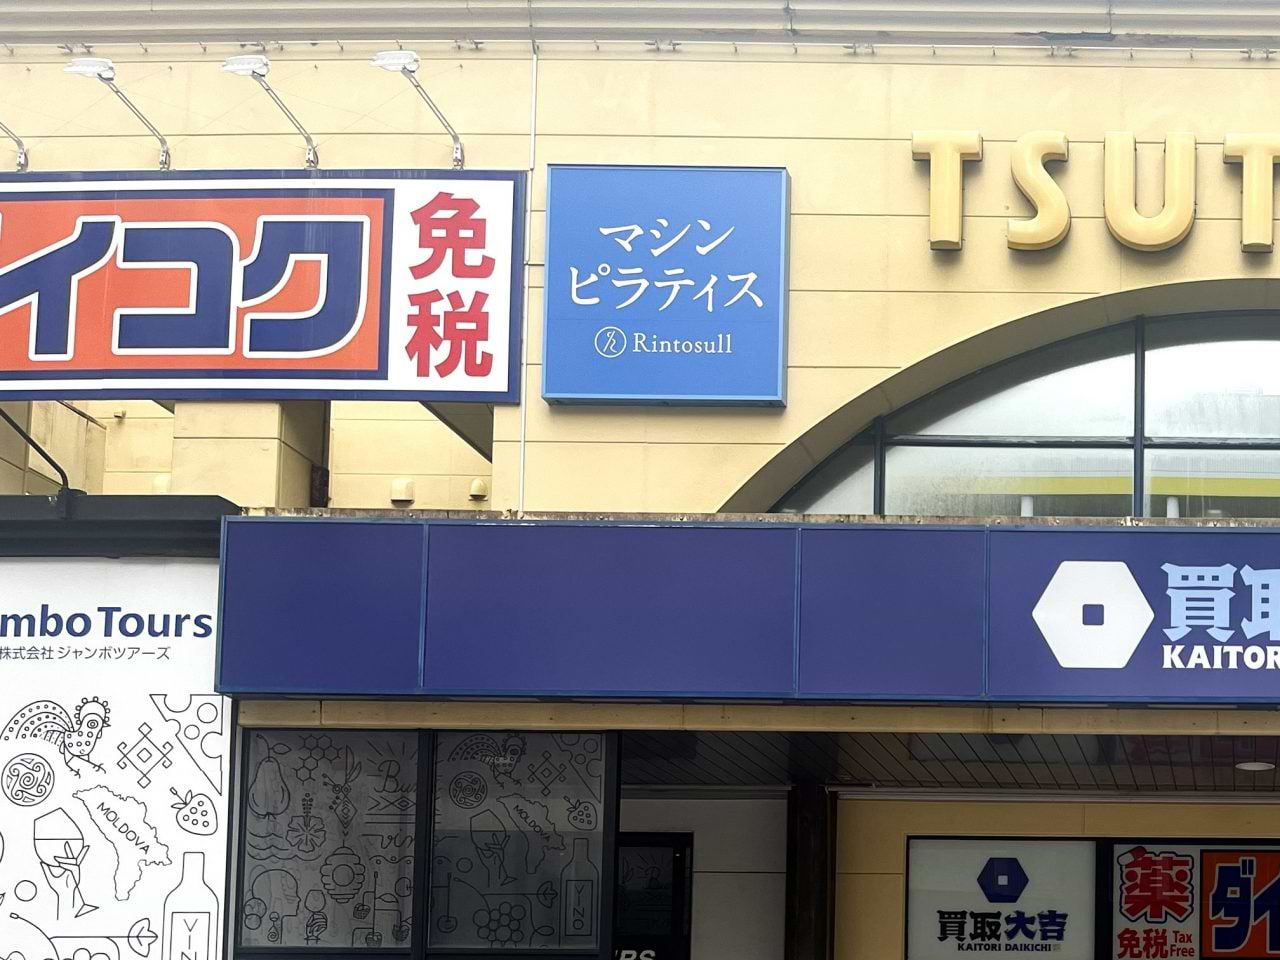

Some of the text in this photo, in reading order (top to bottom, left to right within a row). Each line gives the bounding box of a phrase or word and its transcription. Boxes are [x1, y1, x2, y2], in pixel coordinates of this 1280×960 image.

[598, 219, 735, 259] マシン
[405, 191, 496, 379] 免税
[570, 263, 765, 313] ピラティス
[632, 332, 733, 355] Rintosull
[0, 603, 213, 638] mbo Tours
[0, 645, 171, 660] 株式会社 ジャンボツアーズ
[96, 801, 150, 855] MOLDOVA
[1119, 849, 1193, 923] 薬
[572, 884, 586, 931] VINO
[936, 909, 1068, 942] 買取大吉
[1172, 930, 1193, 943] Tax
[957, 942, 1051, 952] KAITORI DAIKICHI
[1117, 927, 1169, 959] 免税
[1169, 943, 1195, 957] Free
